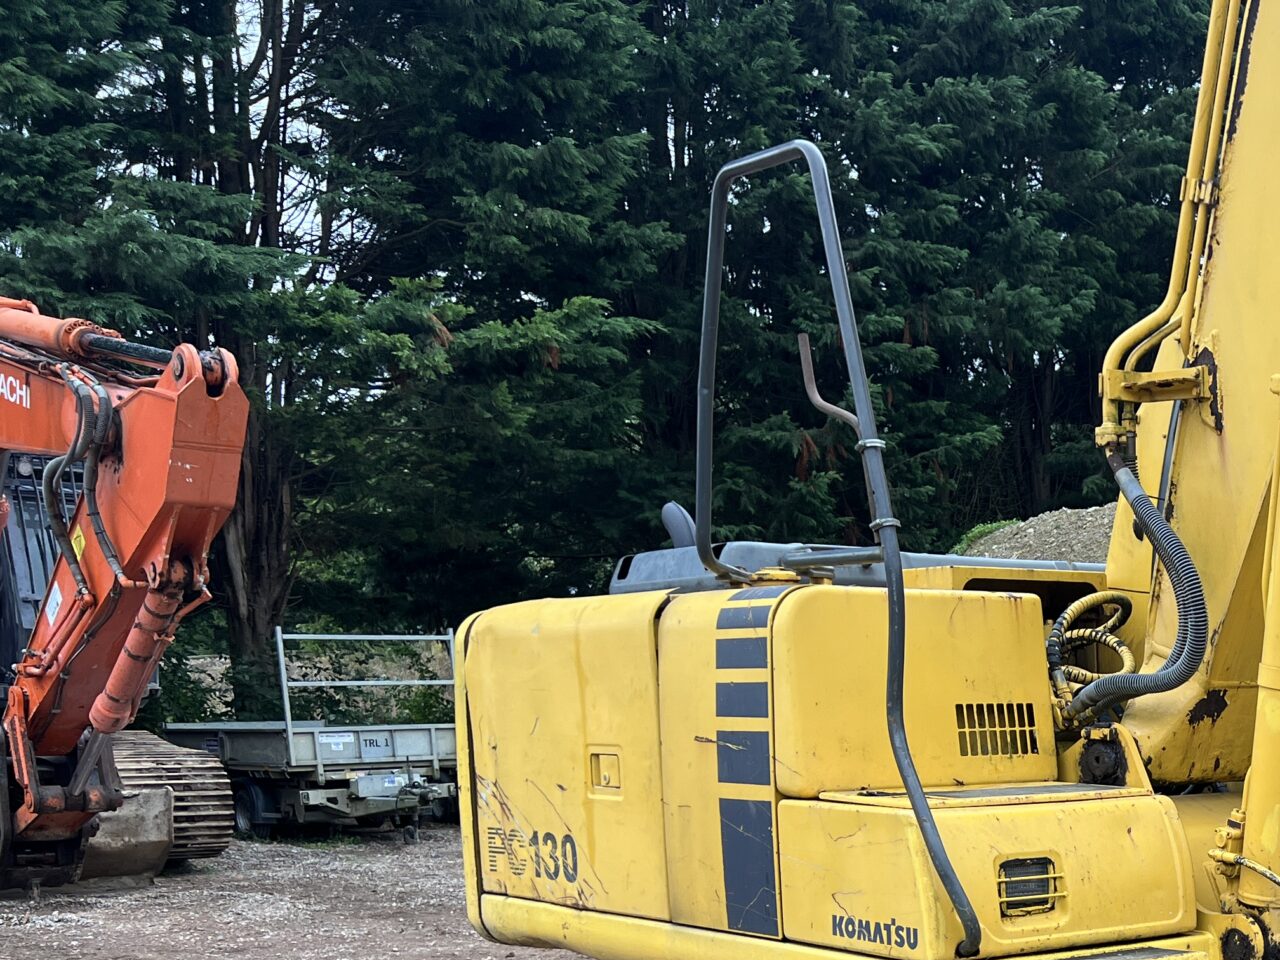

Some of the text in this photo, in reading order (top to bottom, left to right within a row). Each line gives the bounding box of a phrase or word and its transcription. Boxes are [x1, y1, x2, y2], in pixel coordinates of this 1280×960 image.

[363, 738, 390, 748] TRL 1
[831, 914, 918, 951] KOMATSU
